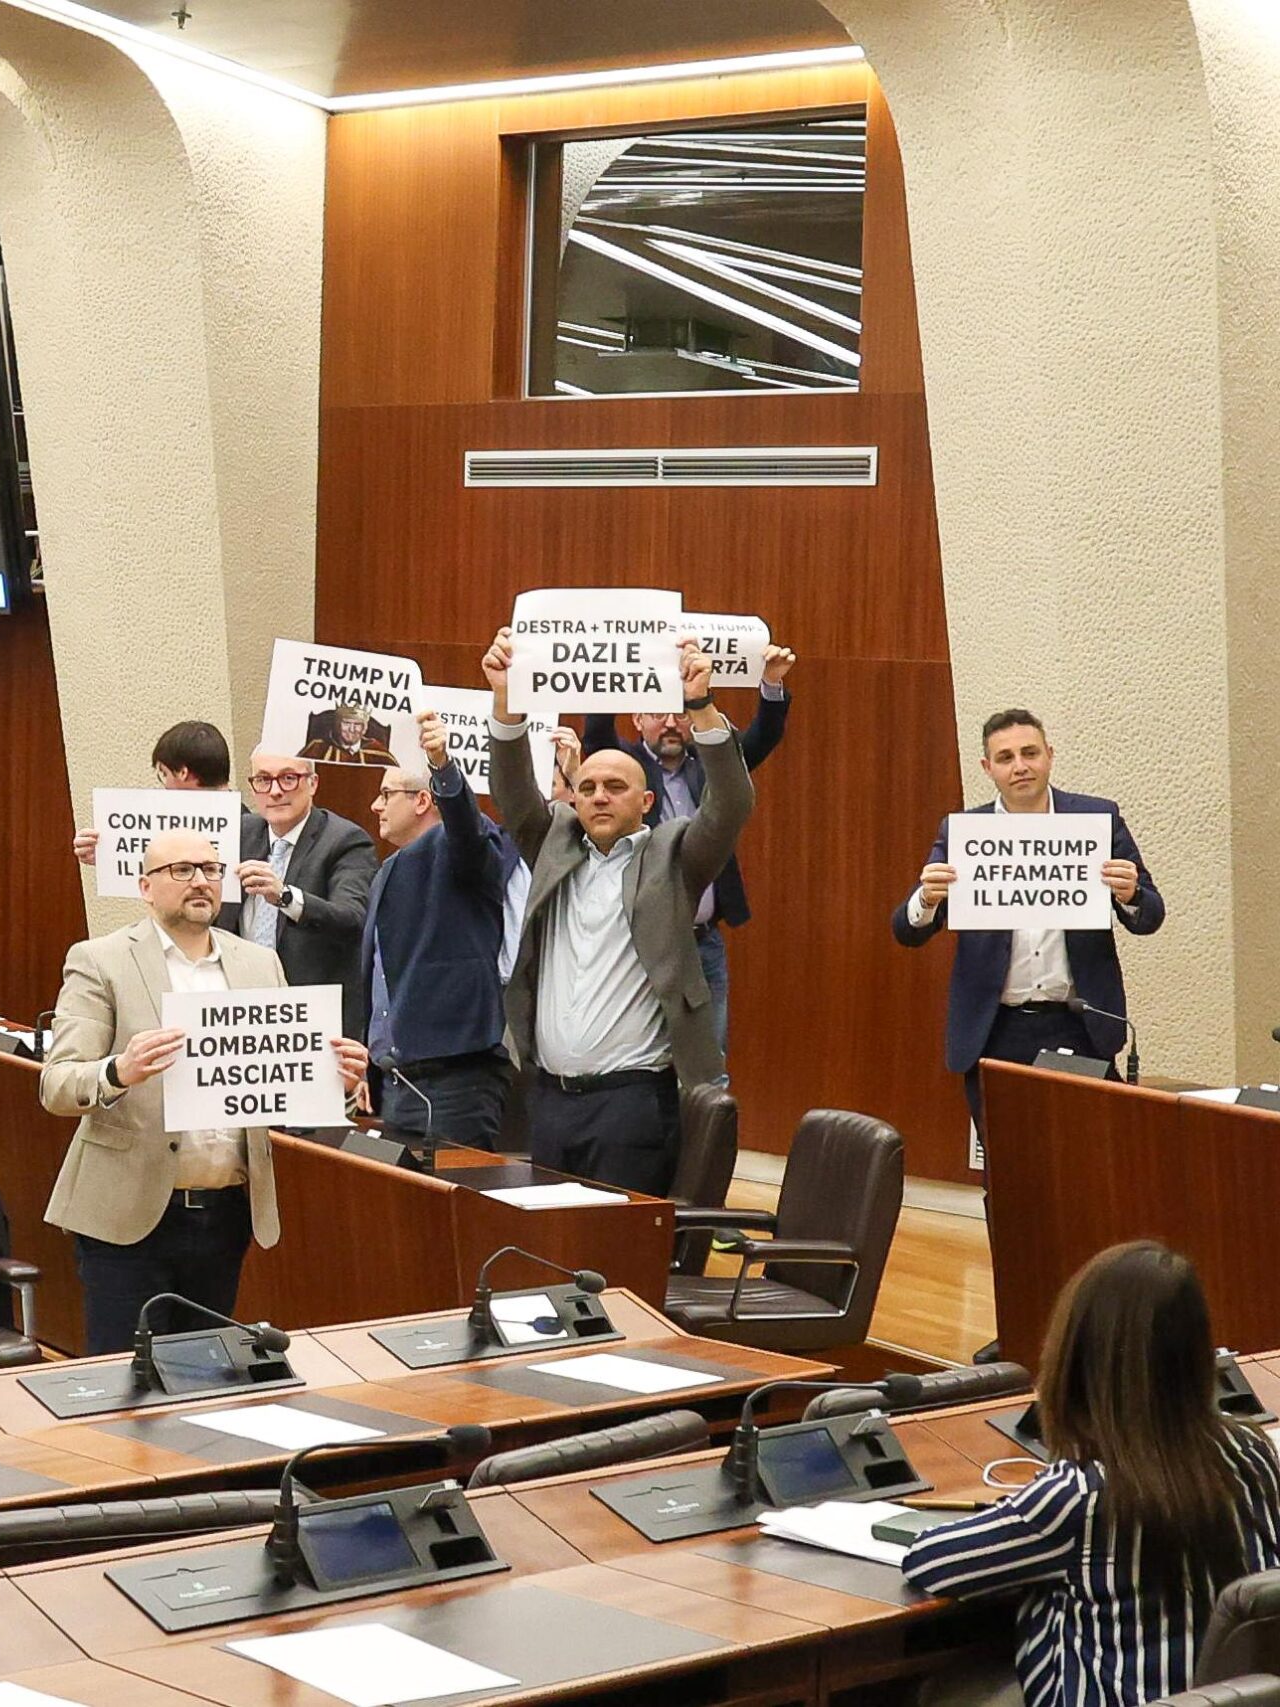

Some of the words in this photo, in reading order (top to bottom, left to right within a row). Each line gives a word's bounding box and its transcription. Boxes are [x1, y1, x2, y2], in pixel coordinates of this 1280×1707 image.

[516, 619, 587, 634] DESTRA
[552, 642, 617, 663] DAZI
[626, 642, 641, 663] E
[701, 637, 720, 654] ZI
[726, 638, 738, 655] E
[303, 657, 384, 685] TRUMP
[388, 670, 411, 690] VI
[532, 667, 662, 693] POVERTÀ
[294, 679, 413, 714] COMANDA
[437, 712, 478, 727] STRA
[448, 732, 490, 752] DAZ
[107, 812, 152, 830] CON
[156, 815, 228, 832] TRUMP
[964, 839, 1013, 857] CON
[1018, 839, 1098, 857] TRUMP
[118, 860, 134, 876] IL
[972, 864, 1088, 882] AFFAMATE
[974, 889, 992, 907] IL
[998, 889, 1088, 907] LAVORO
[201, 1002, 308, 1028] IMPRESE
[186, 1031, 323, 1058] LOMBARDE
[196, 1062, 314, 1087] LASCIATE
[224, 1092, 287, 1116] SOLE
